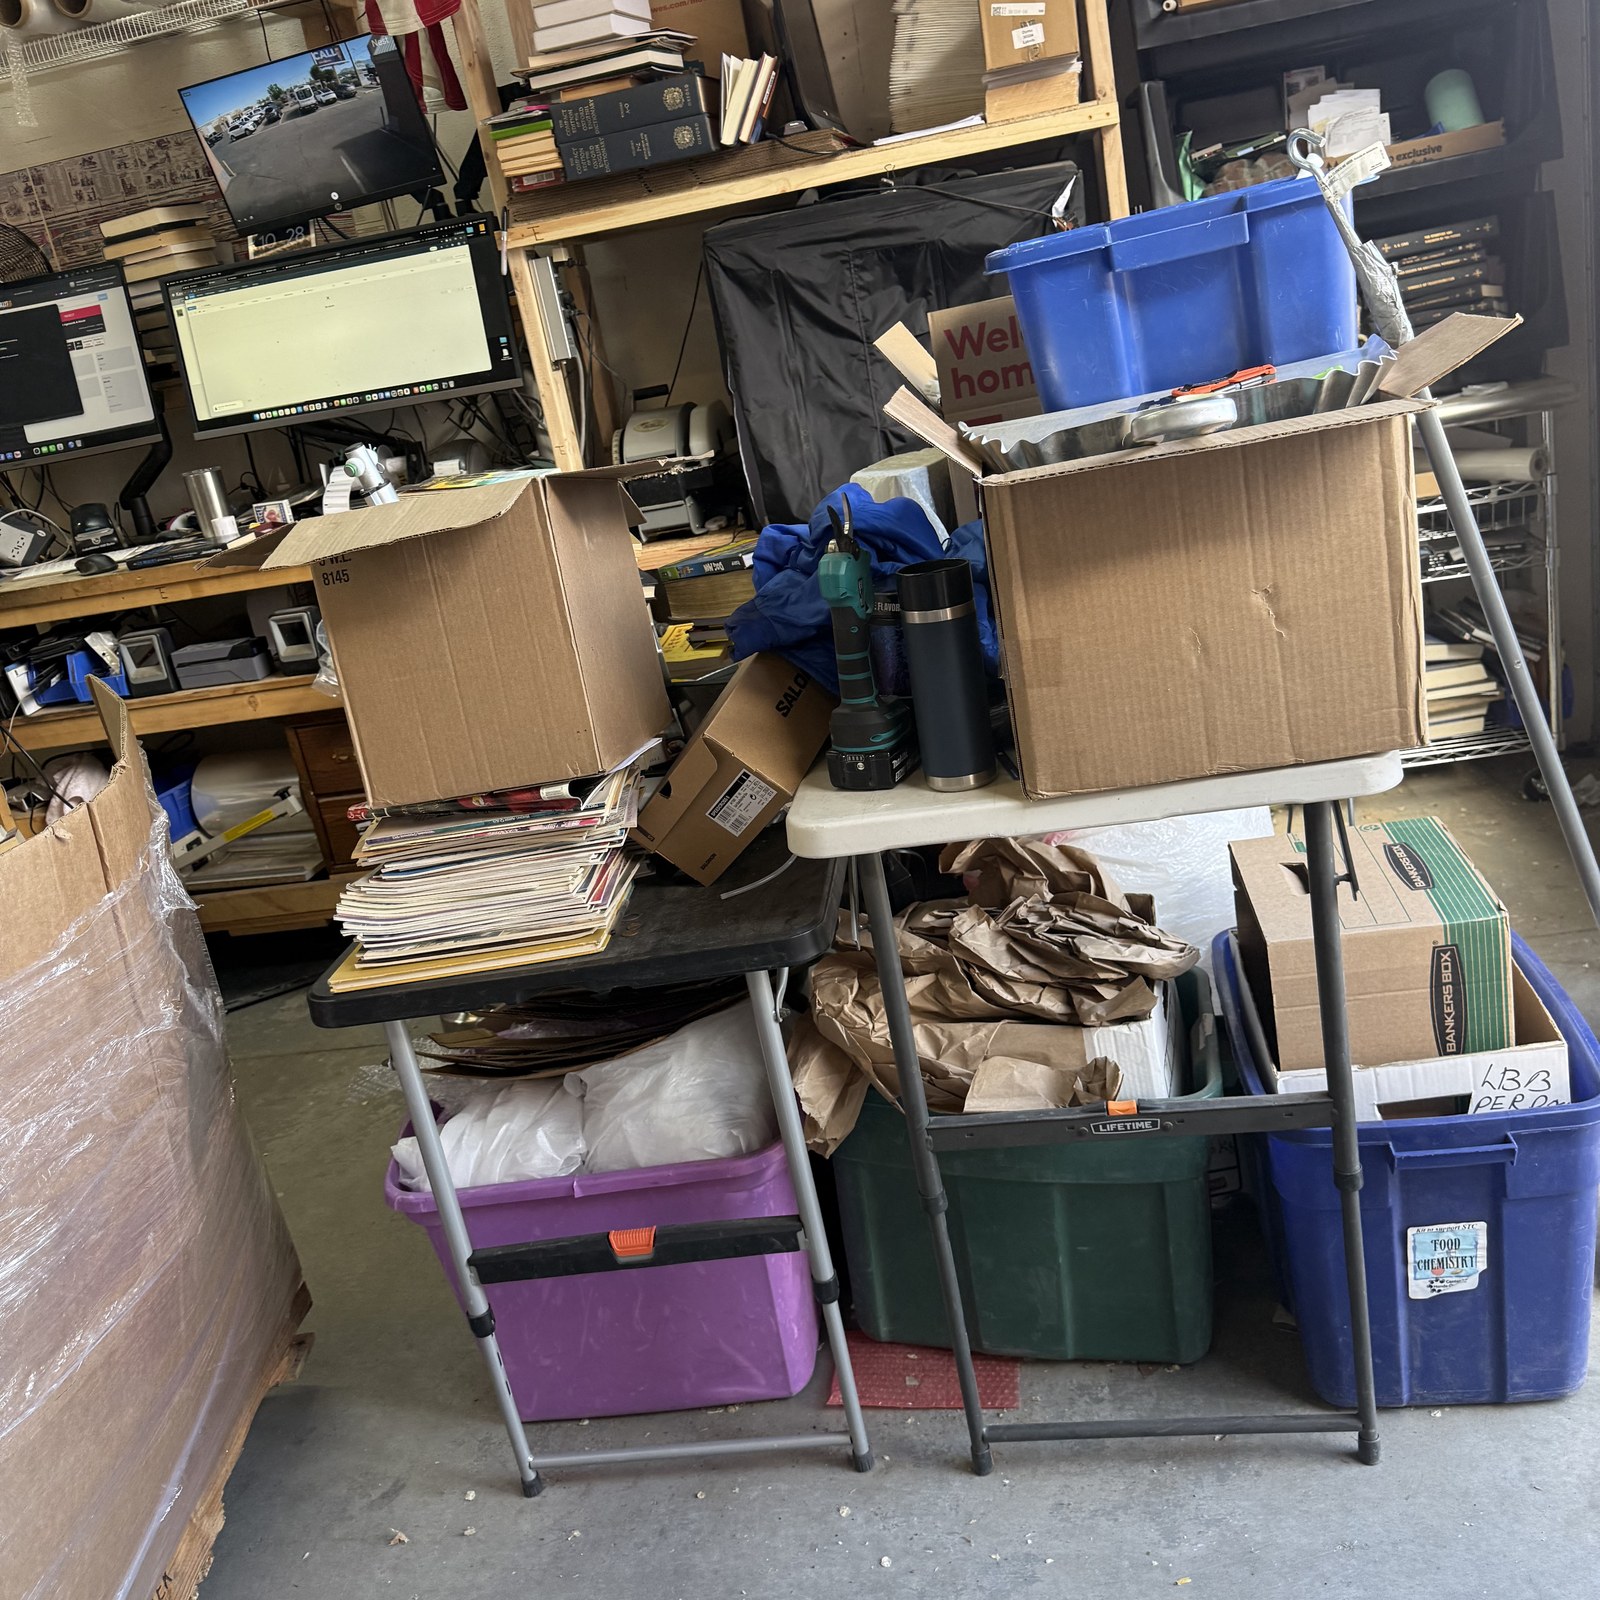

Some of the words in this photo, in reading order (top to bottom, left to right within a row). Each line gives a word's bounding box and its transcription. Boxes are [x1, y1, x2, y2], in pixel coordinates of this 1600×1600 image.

[312, 47, 337, 60] CALL
[562, 110, 571, 136] COMPACT
[568, 109, 577, 133] EDITION
[579, 107, 588, 131] OXFORD
[589, 99, 600, 135] DICTIONARY
[572, 147, 582, 174] COMPACT
[579, 147, 588, 171] EDITION
[589, 145, 599, 169] OXFORD
[598, 137, 611, 173] DICTIONARY
[1396, 144, 1443, 161] exclusive
[286, 226, 305, 242] 28
[322, 569, 350, 586] 8145
[1391, 845, 1407, 858] BOX
[1400, 857, 1426, 887] BANKERS
[1440, 951, 1452, 982] BOX
[1443, 985, 1457, 1053] BANKERS
[1099, 1121, 1152, 1132] LIFETIME
[1431, 1238, 1461, 1252] FOOD
[1416, 1255, 1475, 1271] CHEMISTRY
